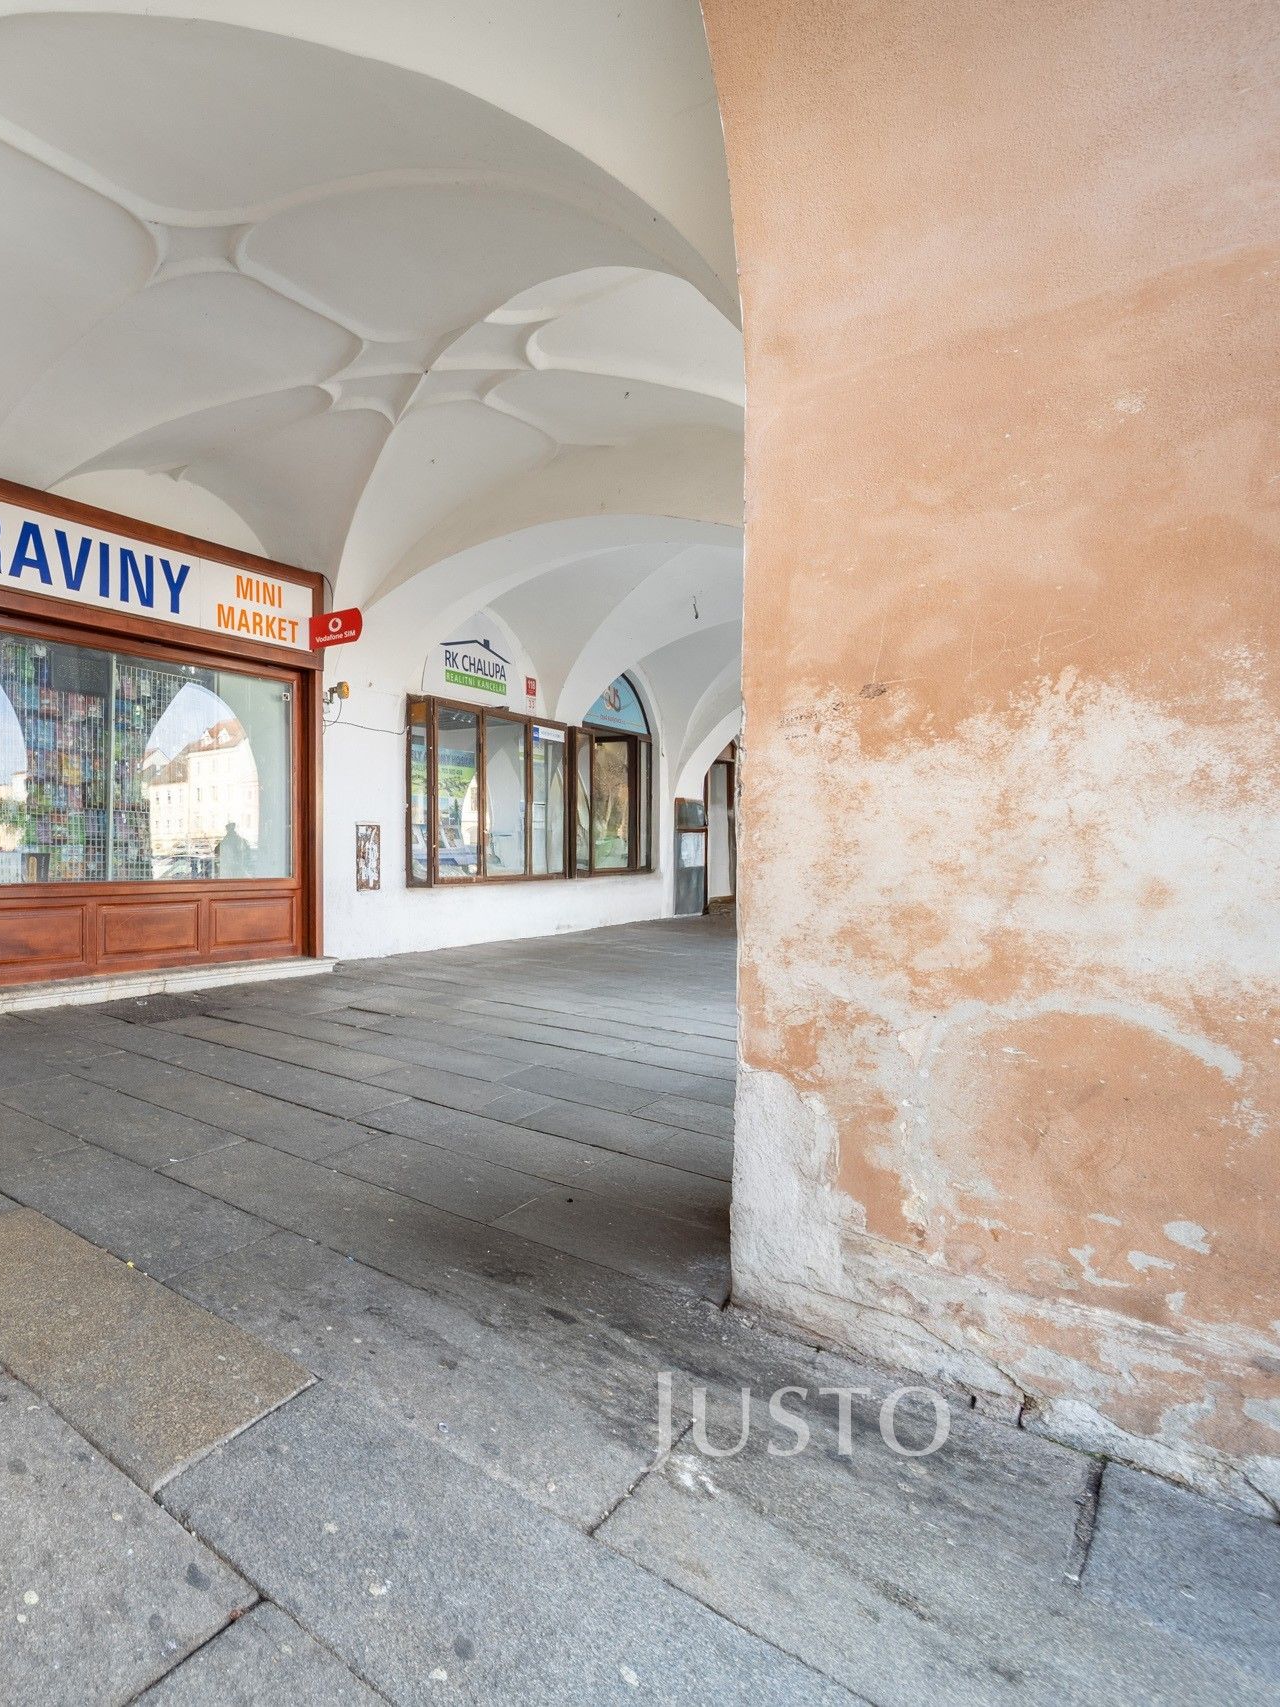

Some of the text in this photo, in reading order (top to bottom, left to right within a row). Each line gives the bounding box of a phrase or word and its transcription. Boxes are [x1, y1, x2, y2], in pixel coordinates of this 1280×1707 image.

[235, 574, 283, 609] MINI
[217, 603, 299, 644] MARKET
[315, 629, 356, 643] Vodafone SIM
[444, 649, 507, 682] RK CHALUPA
